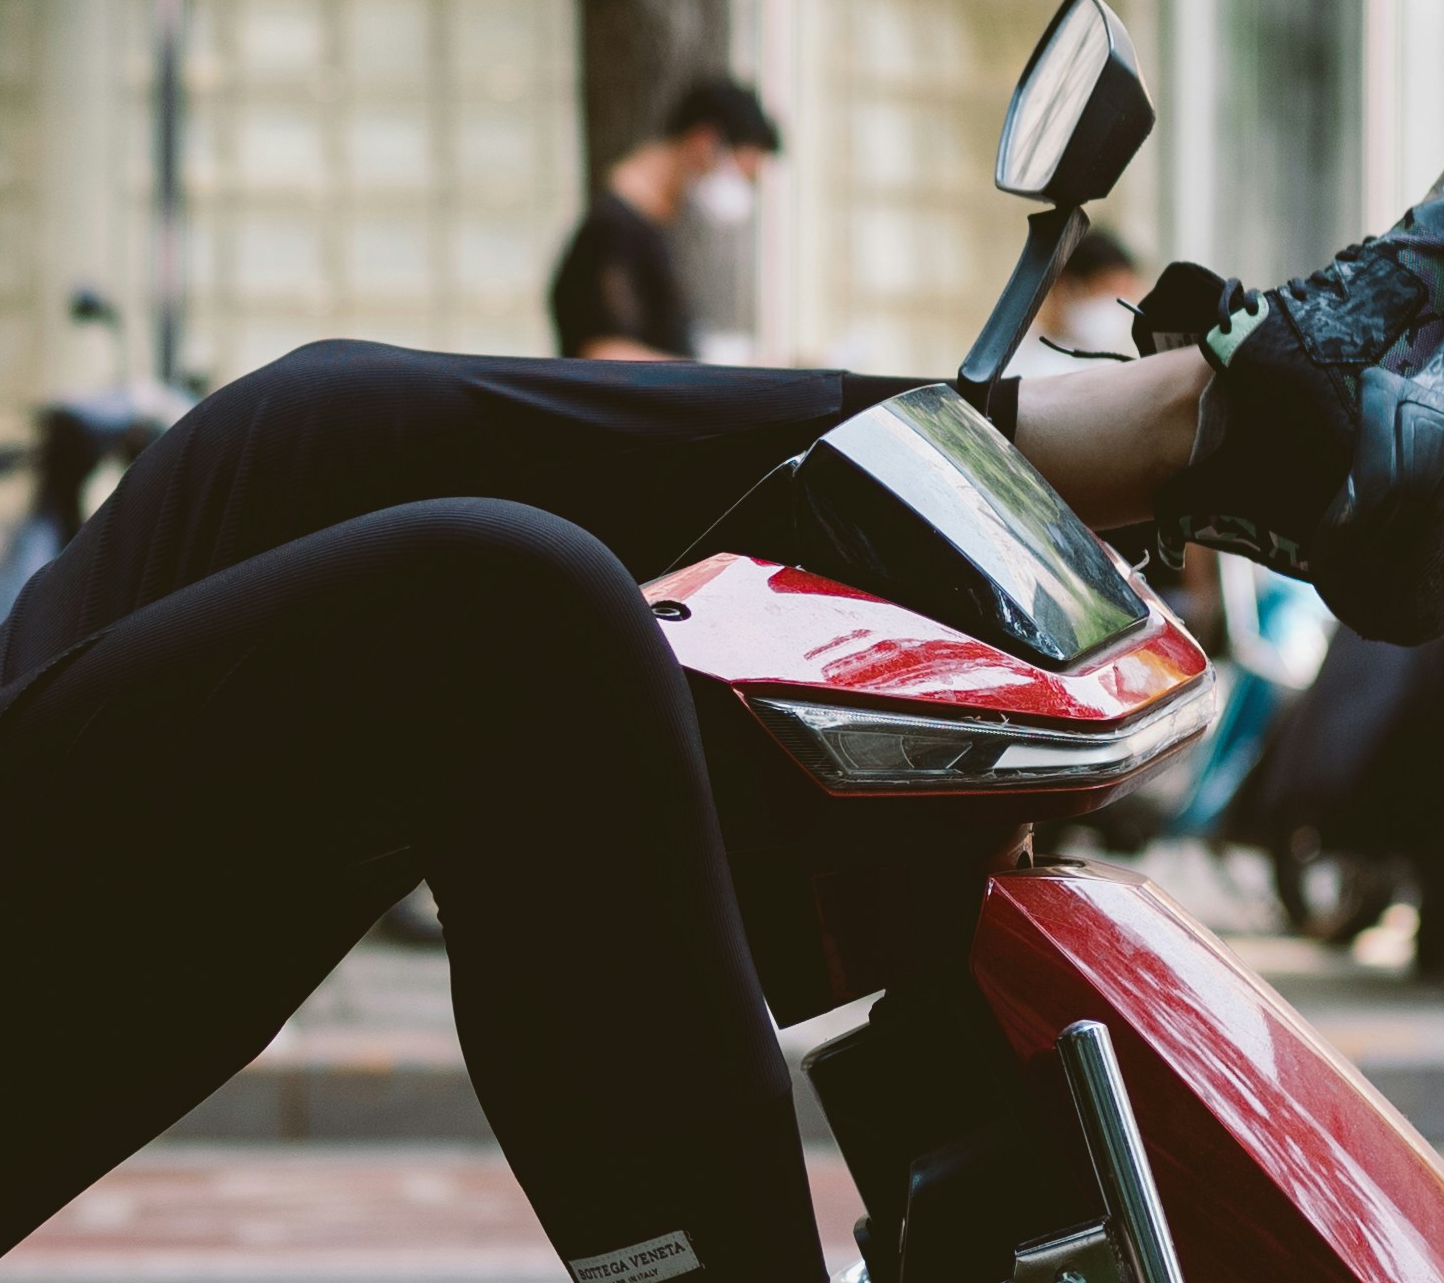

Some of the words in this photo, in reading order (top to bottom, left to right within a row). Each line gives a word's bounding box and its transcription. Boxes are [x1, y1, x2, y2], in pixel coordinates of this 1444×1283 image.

[577, 1260, 630, 1281] BOTTEGA
[629, 1242, 686, 1268] VENETA
[636, 1268, 659, 1281] ITALY
